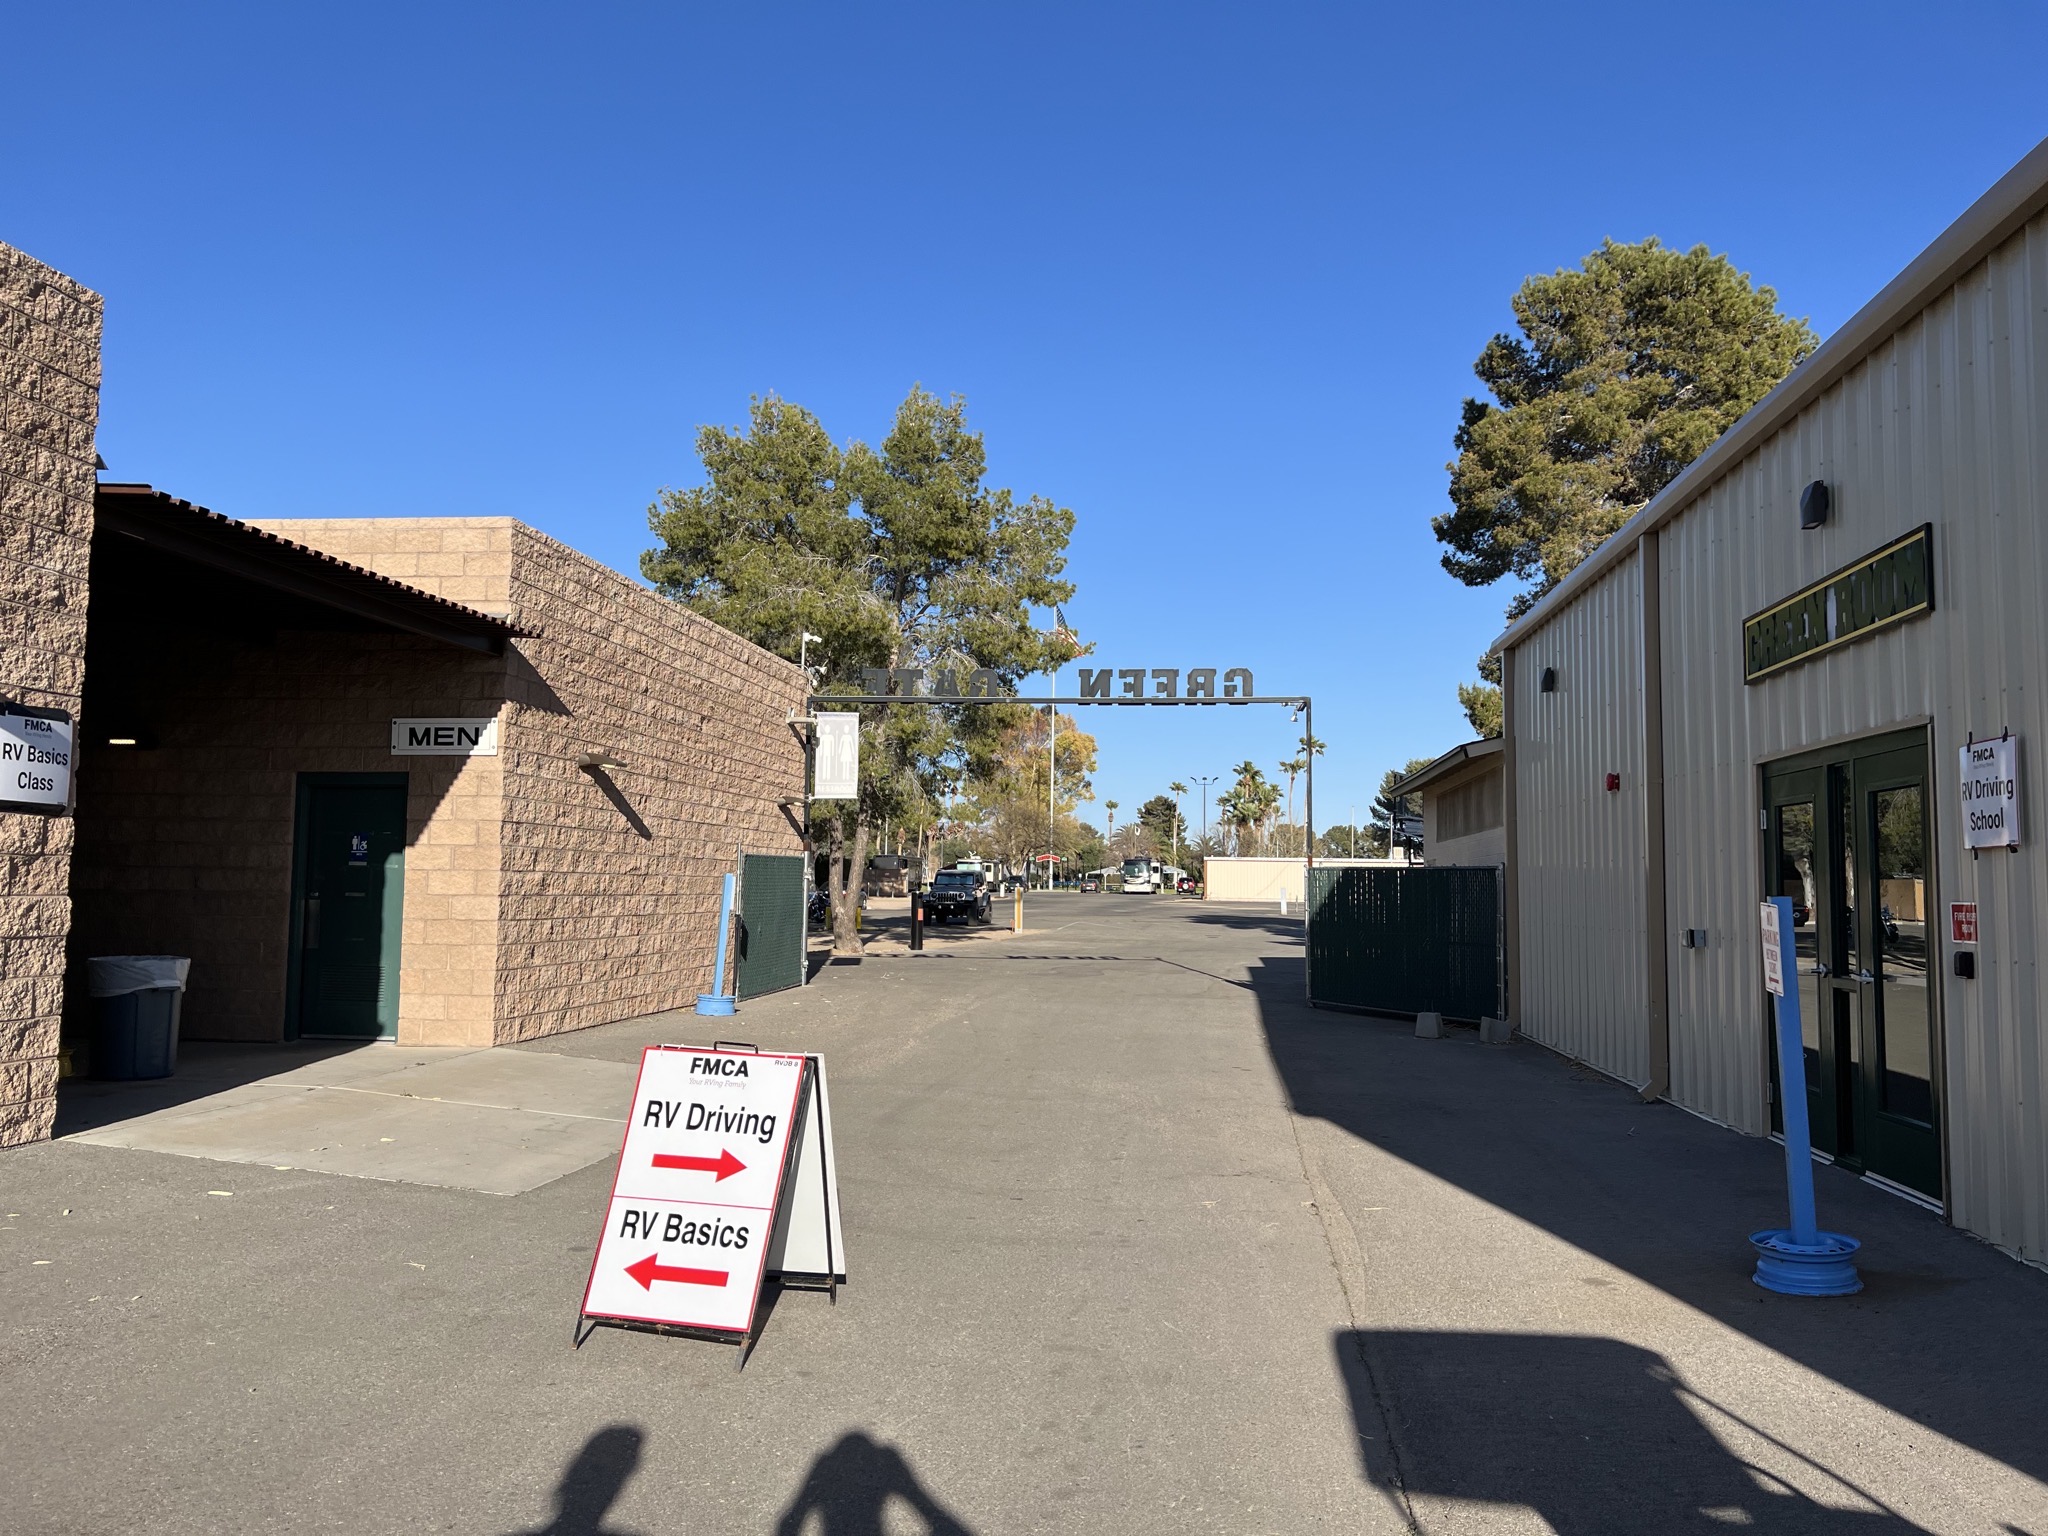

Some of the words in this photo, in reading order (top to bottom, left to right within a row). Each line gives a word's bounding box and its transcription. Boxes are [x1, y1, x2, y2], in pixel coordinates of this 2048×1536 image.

[25, 719, 52, 732] FMCA
[408, 726, 480, 746] MEN
[2, 742, 24, 761] RV
[27, 745, 69, 766] Basics
[1972, 746, 1995, 763] FMCA
[17, 771, 54, 791] Class
[1961, 780, 1974, 802] RV
[1975, 776, 2014, 800] Driving
[1970, 807, 2004, 831] School
[1762, 928, 1779, 947] PARKING
[689, 1057, 749, 1078] FMCA
[688, 1078, 704, 1086] Your
[704, 1079, 724, 1089] RVing
[724, 1080, 747, 1091] Family
[643, 1100, 682, 1129] RV
[685, 1102, 777, 1144] Driving
[619, 1209, 659, 1239] RV
[662, 1213, 749, 1250] Basics
